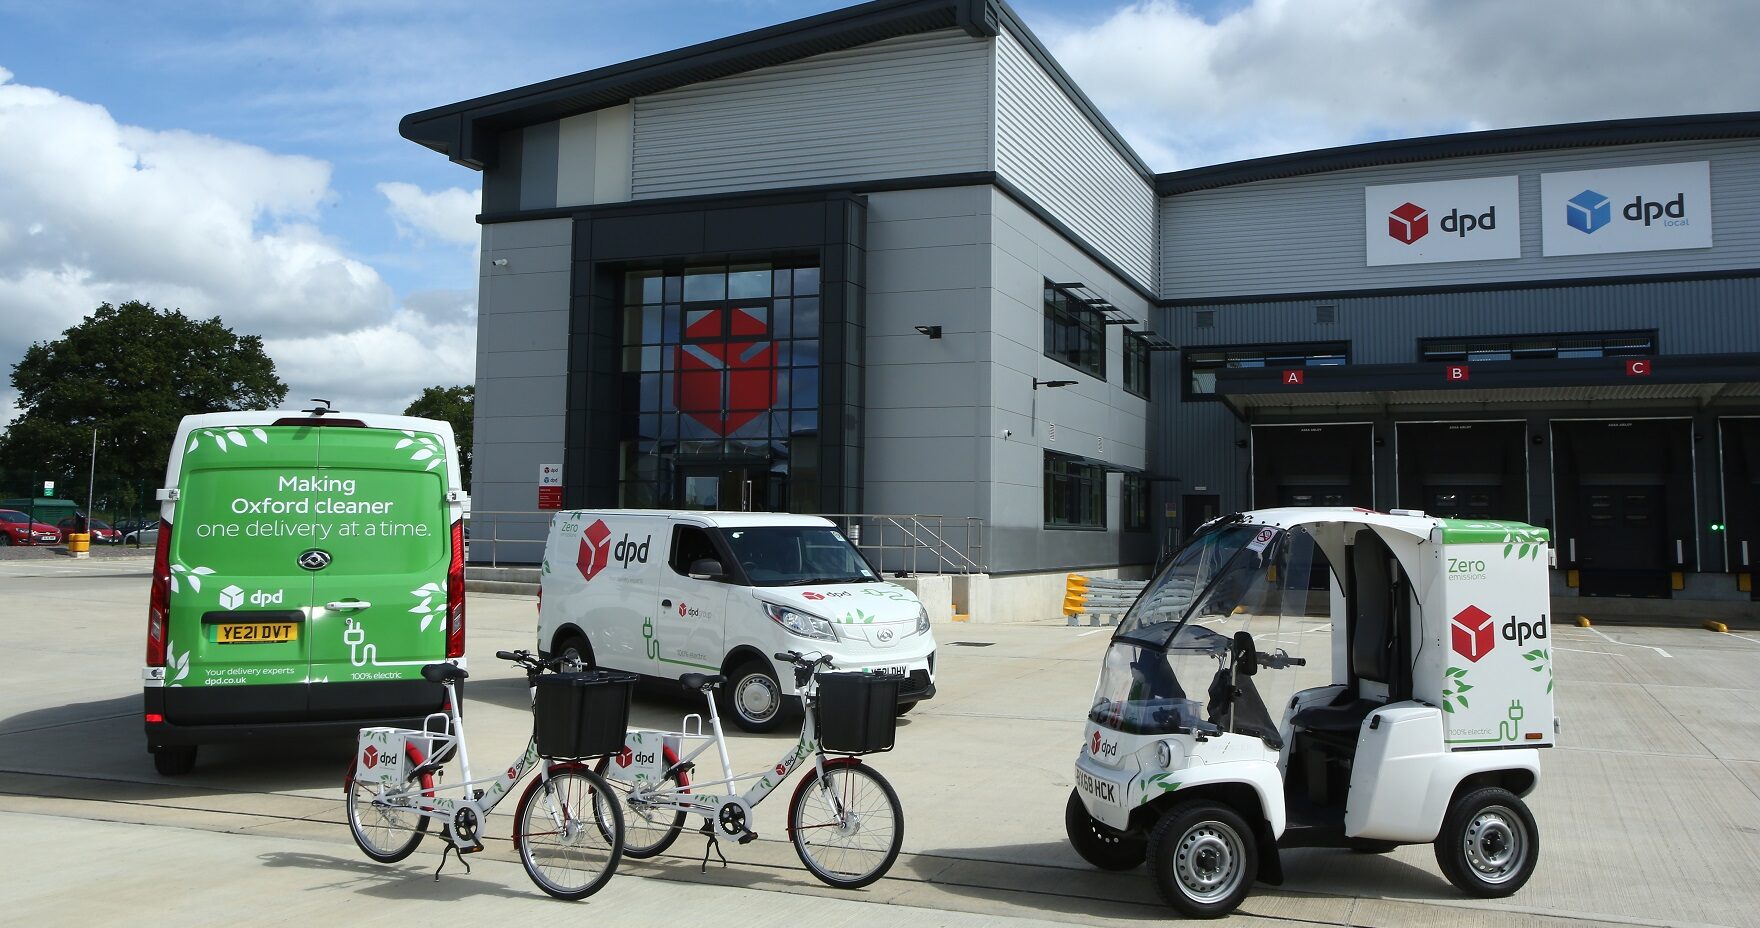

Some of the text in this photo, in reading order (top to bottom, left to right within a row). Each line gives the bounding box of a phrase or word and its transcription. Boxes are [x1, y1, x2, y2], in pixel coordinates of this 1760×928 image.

[1623, 193, 1684, 226] dpd
[1440, 206, 1495, 237] dpd
[1664, 218, 1690, 227] local
[1452, 368, 1462, 379] B
[1632, 362, 1643, 373] C
[1288, 372, 1298, 382] A
[279, 476, 356, 495] Making
[231, 498, 393, 514] Oxford cleaner
[197, 520, 431, 540] one delivery at a time.
[561, 522, 579, 533] Zero
[614, 533, 651, 569] dpd
[1448, 558, 1485, 573] Zero
[1449, 573, 1486, 581] emissions
[250, 589, 283, 607] dpd
[223, 625, 292, 640] YE21 DVT
[1502, 614, 1547, 646] dpd
[227, 668, 261, 676] delivery
[262, 667, 295, 675] experts
[352, 672, 372, 680] 100%
[205, 677, 247, 686] dpd.co.uk
[1468, 728, 1492, 736] electric
[1102, 739, 1118, 757] dpd
[380, 752, 397, 766] dpd
[635, 751, 654, 765] dpd
[1094, 779, 1115, 803] HCK
